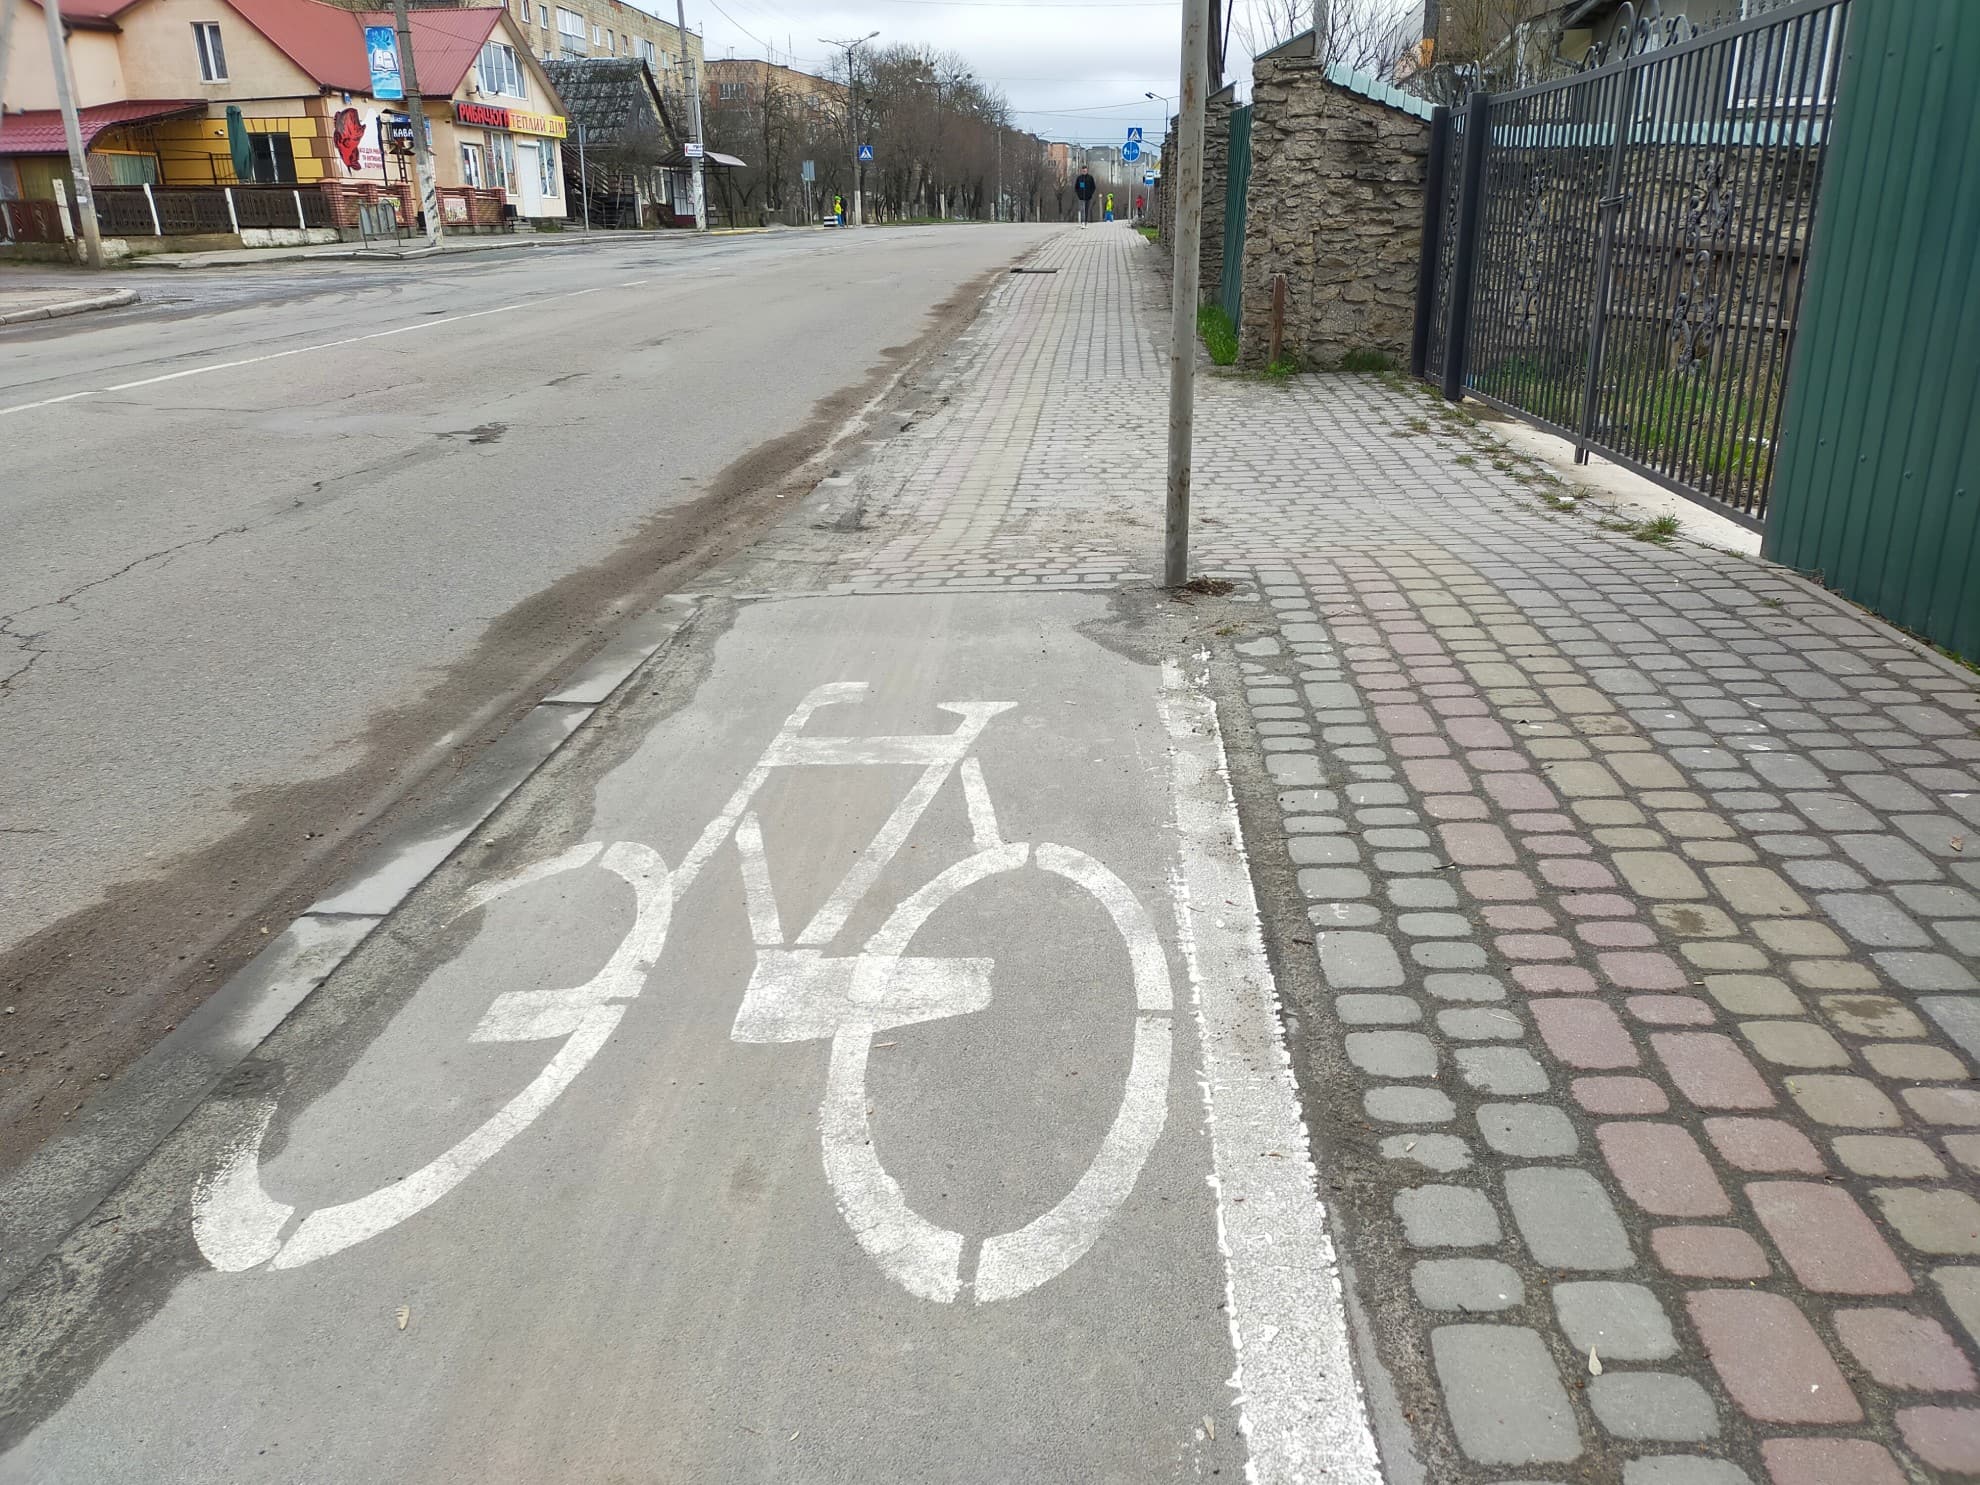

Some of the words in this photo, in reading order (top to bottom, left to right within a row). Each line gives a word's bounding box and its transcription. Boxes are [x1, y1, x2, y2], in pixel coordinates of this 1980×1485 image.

[511, 114, 545, 131] ТЕПЛИЙ
[549, 120, 563, 134] ДІМ
[393, 128, 414, 138] КАВА
